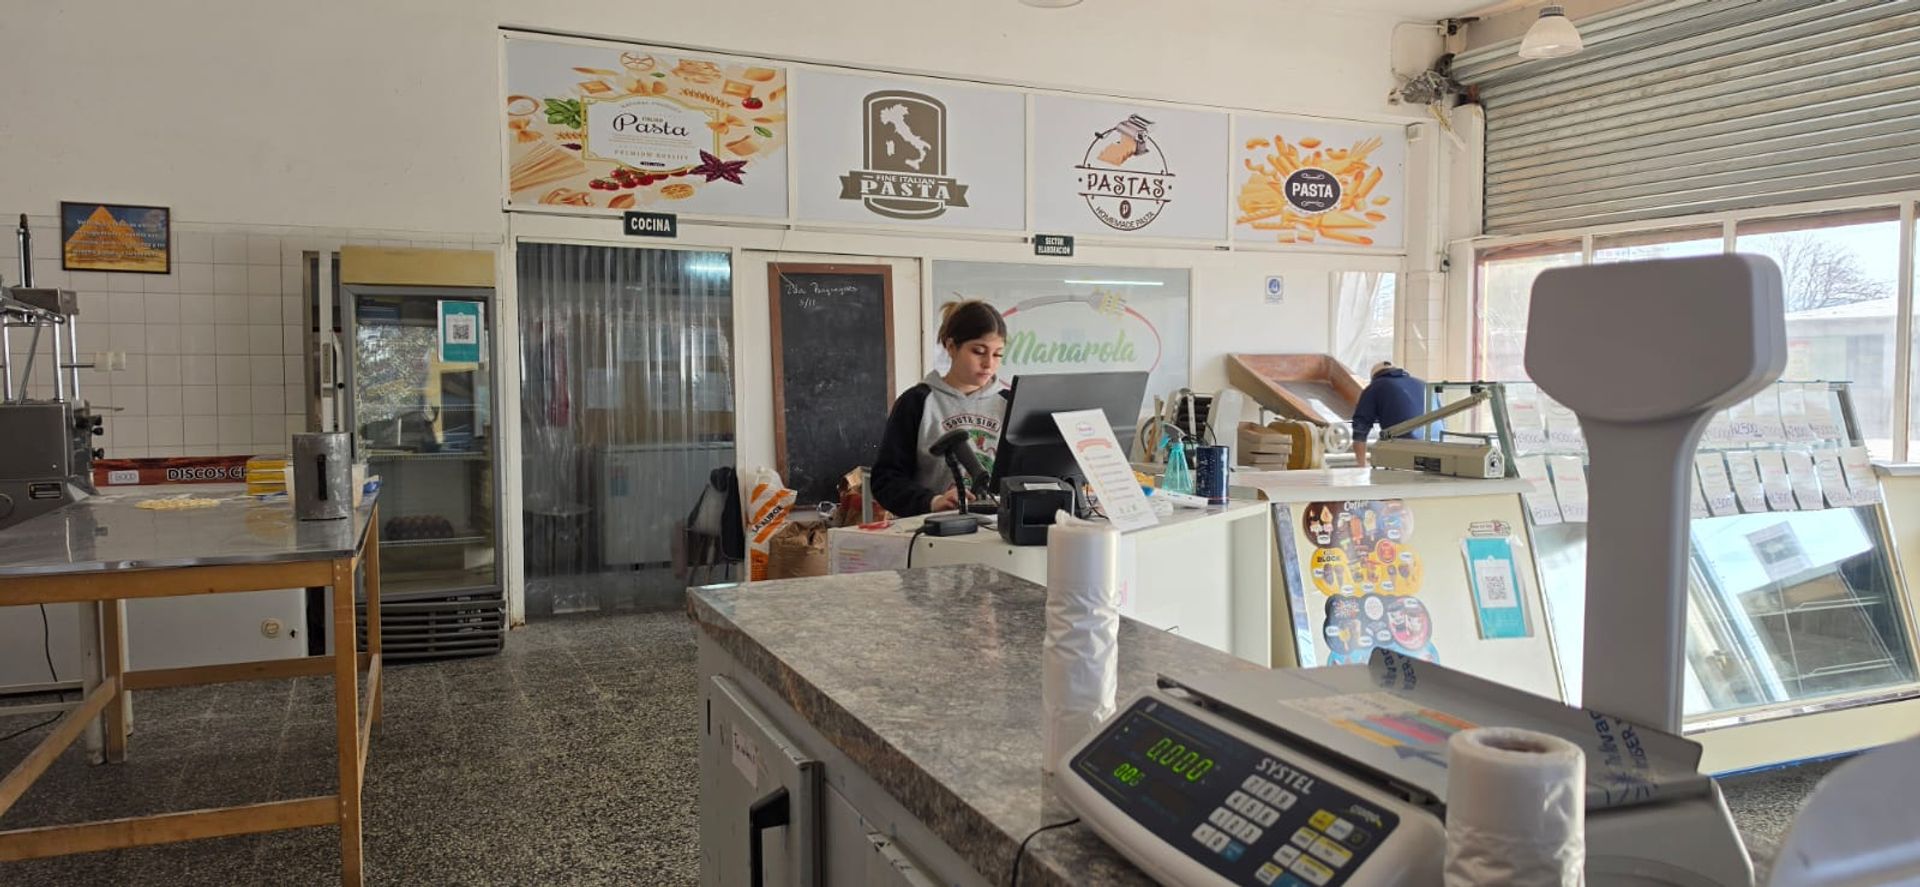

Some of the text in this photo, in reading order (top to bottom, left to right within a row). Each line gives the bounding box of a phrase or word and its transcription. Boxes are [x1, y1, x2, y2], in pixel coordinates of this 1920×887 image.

[612, 113, 689, 137] Pasta
[876, 174, 935, 185] FINE ITALIAN
[1087, 173, 1165, 198] PASTAS
[860, 179, 951, 200] PASTA
[1292, 182, 1334, 198] PASTA
[631, 217, 671, 232] COCINA
[1002, 330, 1137, 366] Manarola
[945, 416, 974, 429] SOUTH
[166, 467, 227, 482] DISCOS
[1255, 757, 1315, 794] SYSTEL
